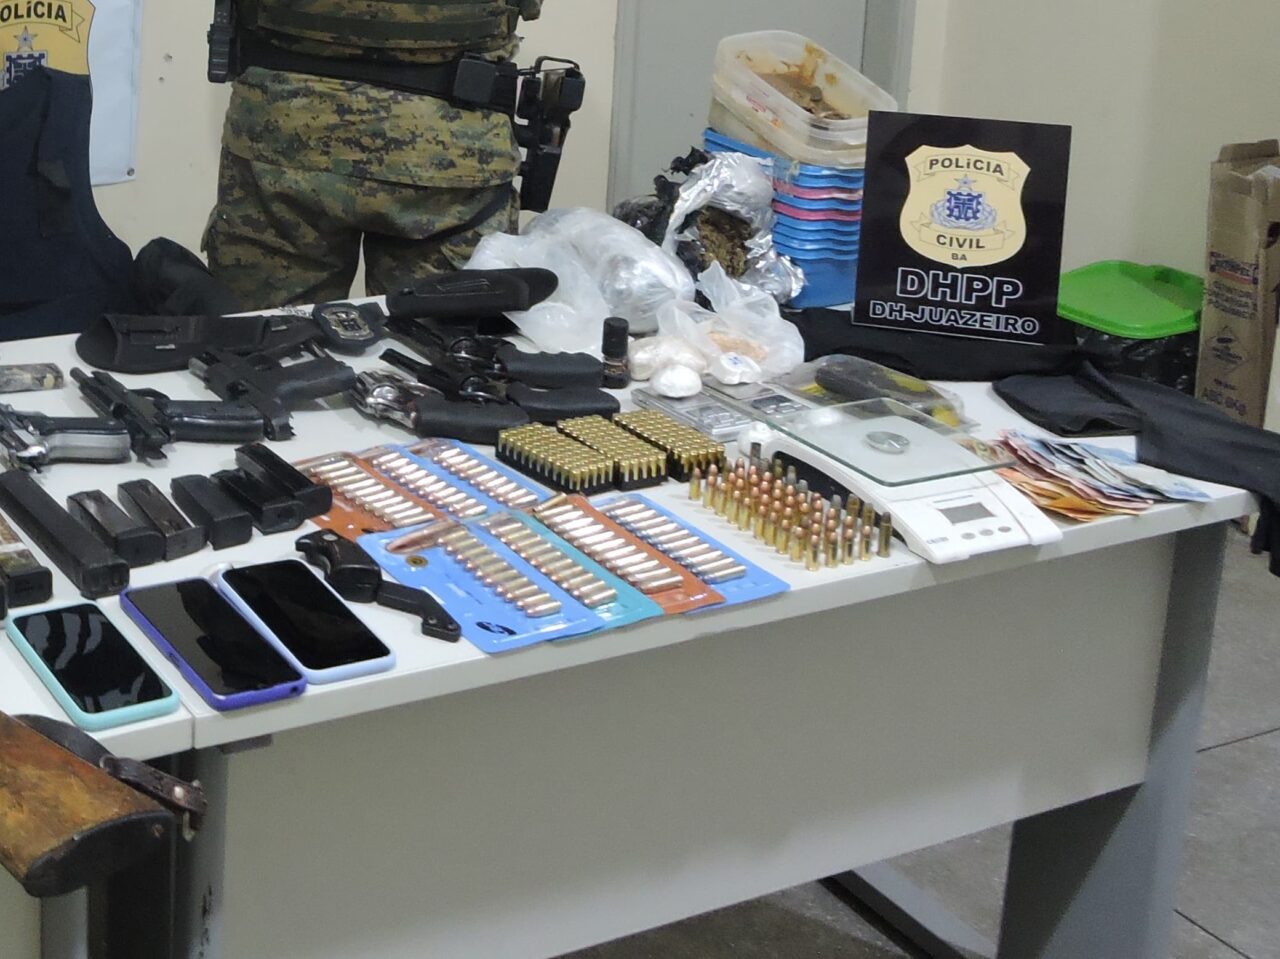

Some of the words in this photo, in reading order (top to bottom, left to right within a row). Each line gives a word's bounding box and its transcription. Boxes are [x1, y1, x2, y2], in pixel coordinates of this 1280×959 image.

[937, 235, 985, 249] CIVIL
[952, 253, 967, 261] BA
[897, 267, 1022, 307] DHPP
[870, 300, 1039, 334] DH-JUAZEIRO
